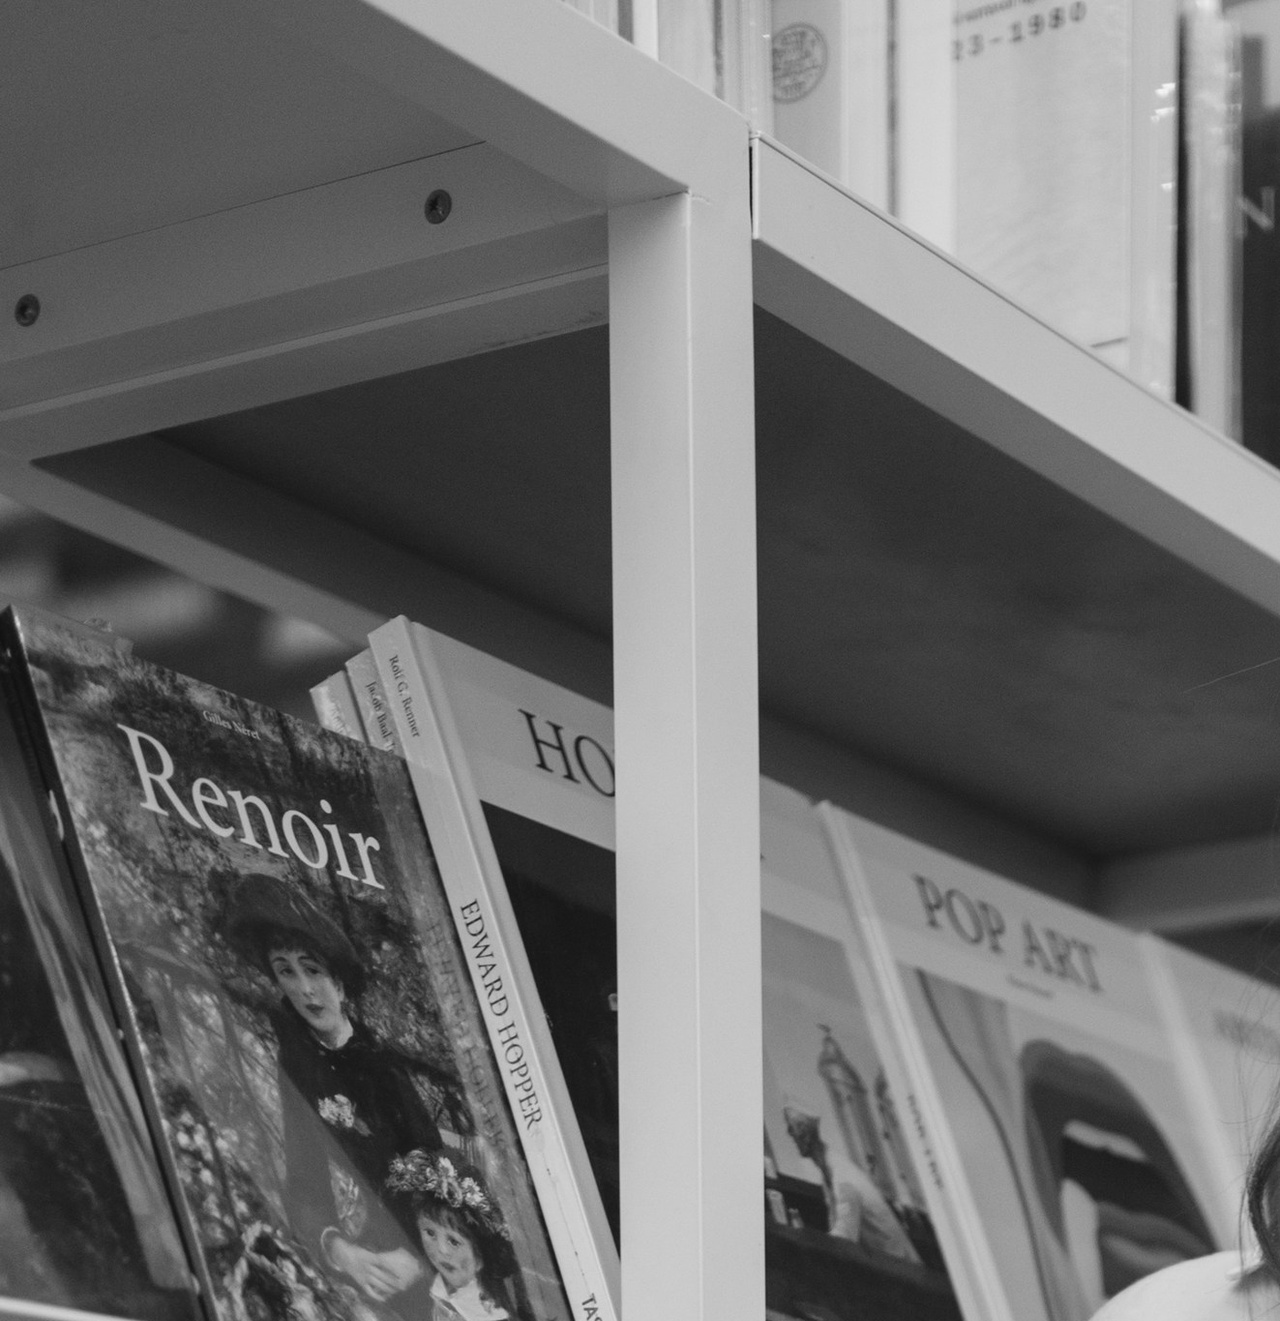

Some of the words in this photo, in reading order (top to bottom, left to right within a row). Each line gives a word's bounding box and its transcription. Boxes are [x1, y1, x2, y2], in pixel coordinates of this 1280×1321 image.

[402, 697, 420, 737] Renner
[117, 723, 385, 889] Renoir
[913, 873, 1006, 954] POP
[1023, 919, 1103, 993] ART
[460, 899, 510, 1017] EDWARD
[497, 1021, 543, 1130] HOPPER
